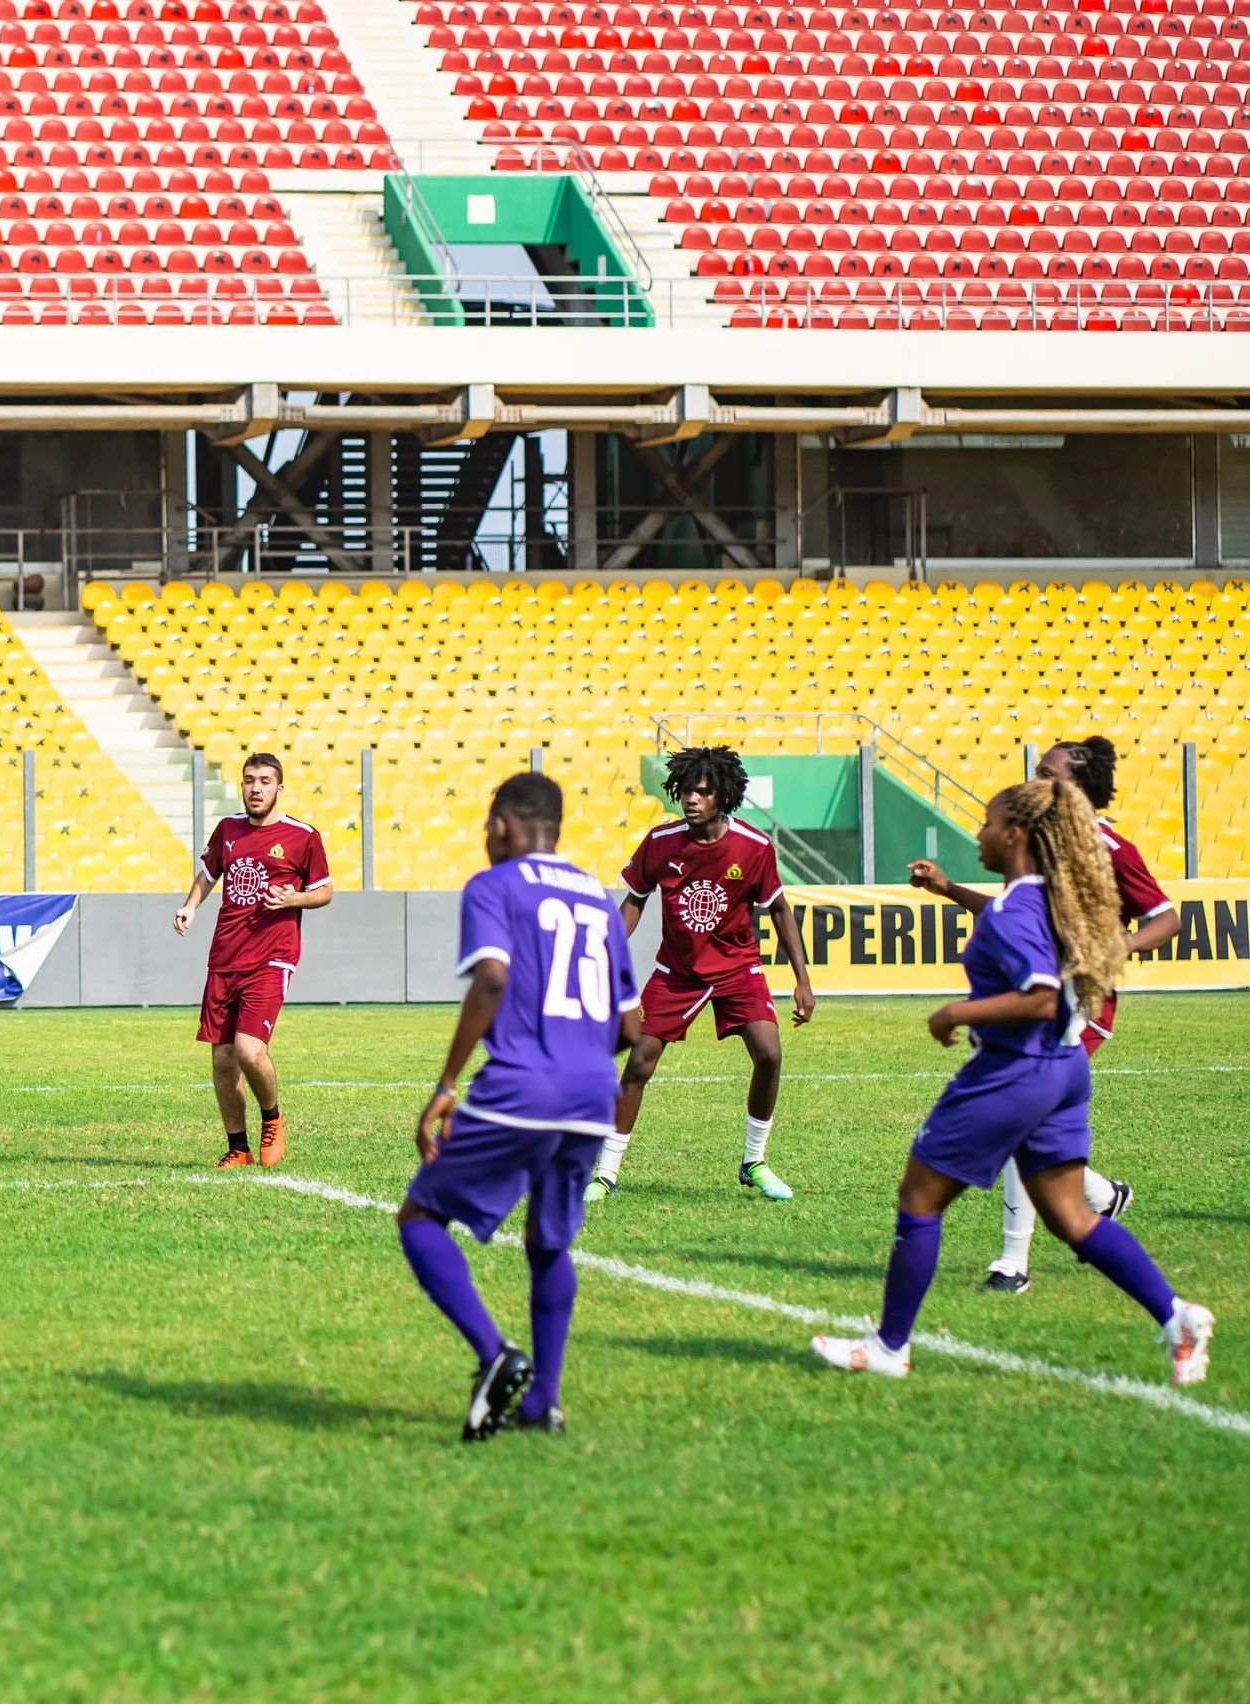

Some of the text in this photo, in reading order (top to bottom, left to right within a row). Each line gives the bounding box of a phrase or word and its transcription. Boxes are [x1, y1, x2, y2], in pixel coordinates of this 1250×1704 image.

[226, 857, 269, 906] FREE THE YOUTH
[679, 879, 728, 933] FREE THE YOUTH
[537, 897, 610, 1023] 23
[752, 904, 982, 967] EXPERIE
